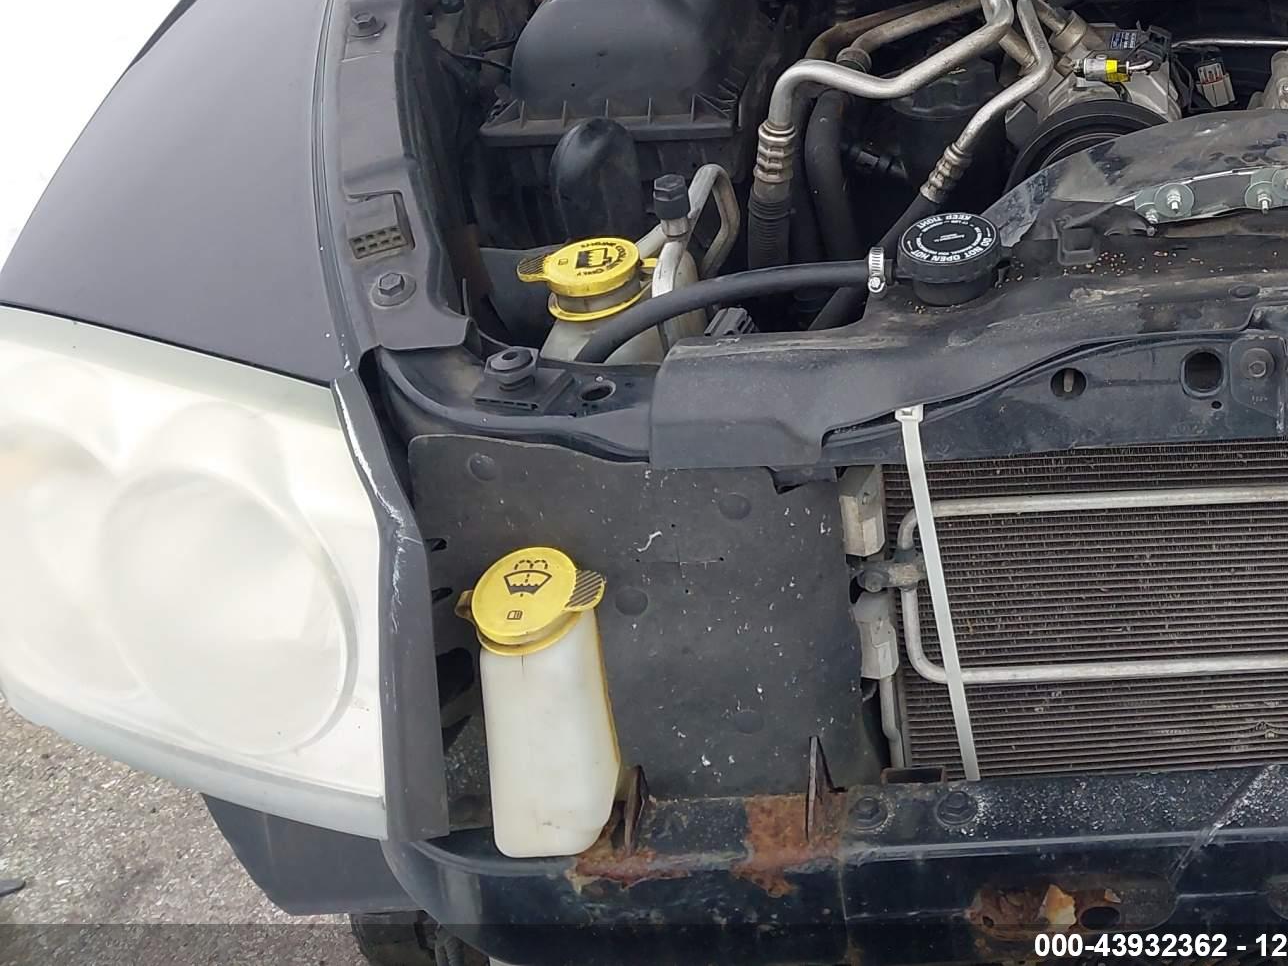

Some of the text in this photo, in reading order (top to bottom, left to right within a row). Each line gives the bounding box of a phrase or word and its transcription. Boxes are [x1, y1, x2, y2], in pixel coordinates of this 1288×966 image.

[981, 237, 993, 247] DO
[911, 249, 929, 260] HOT
[965, 245, 984, 259] NOT
